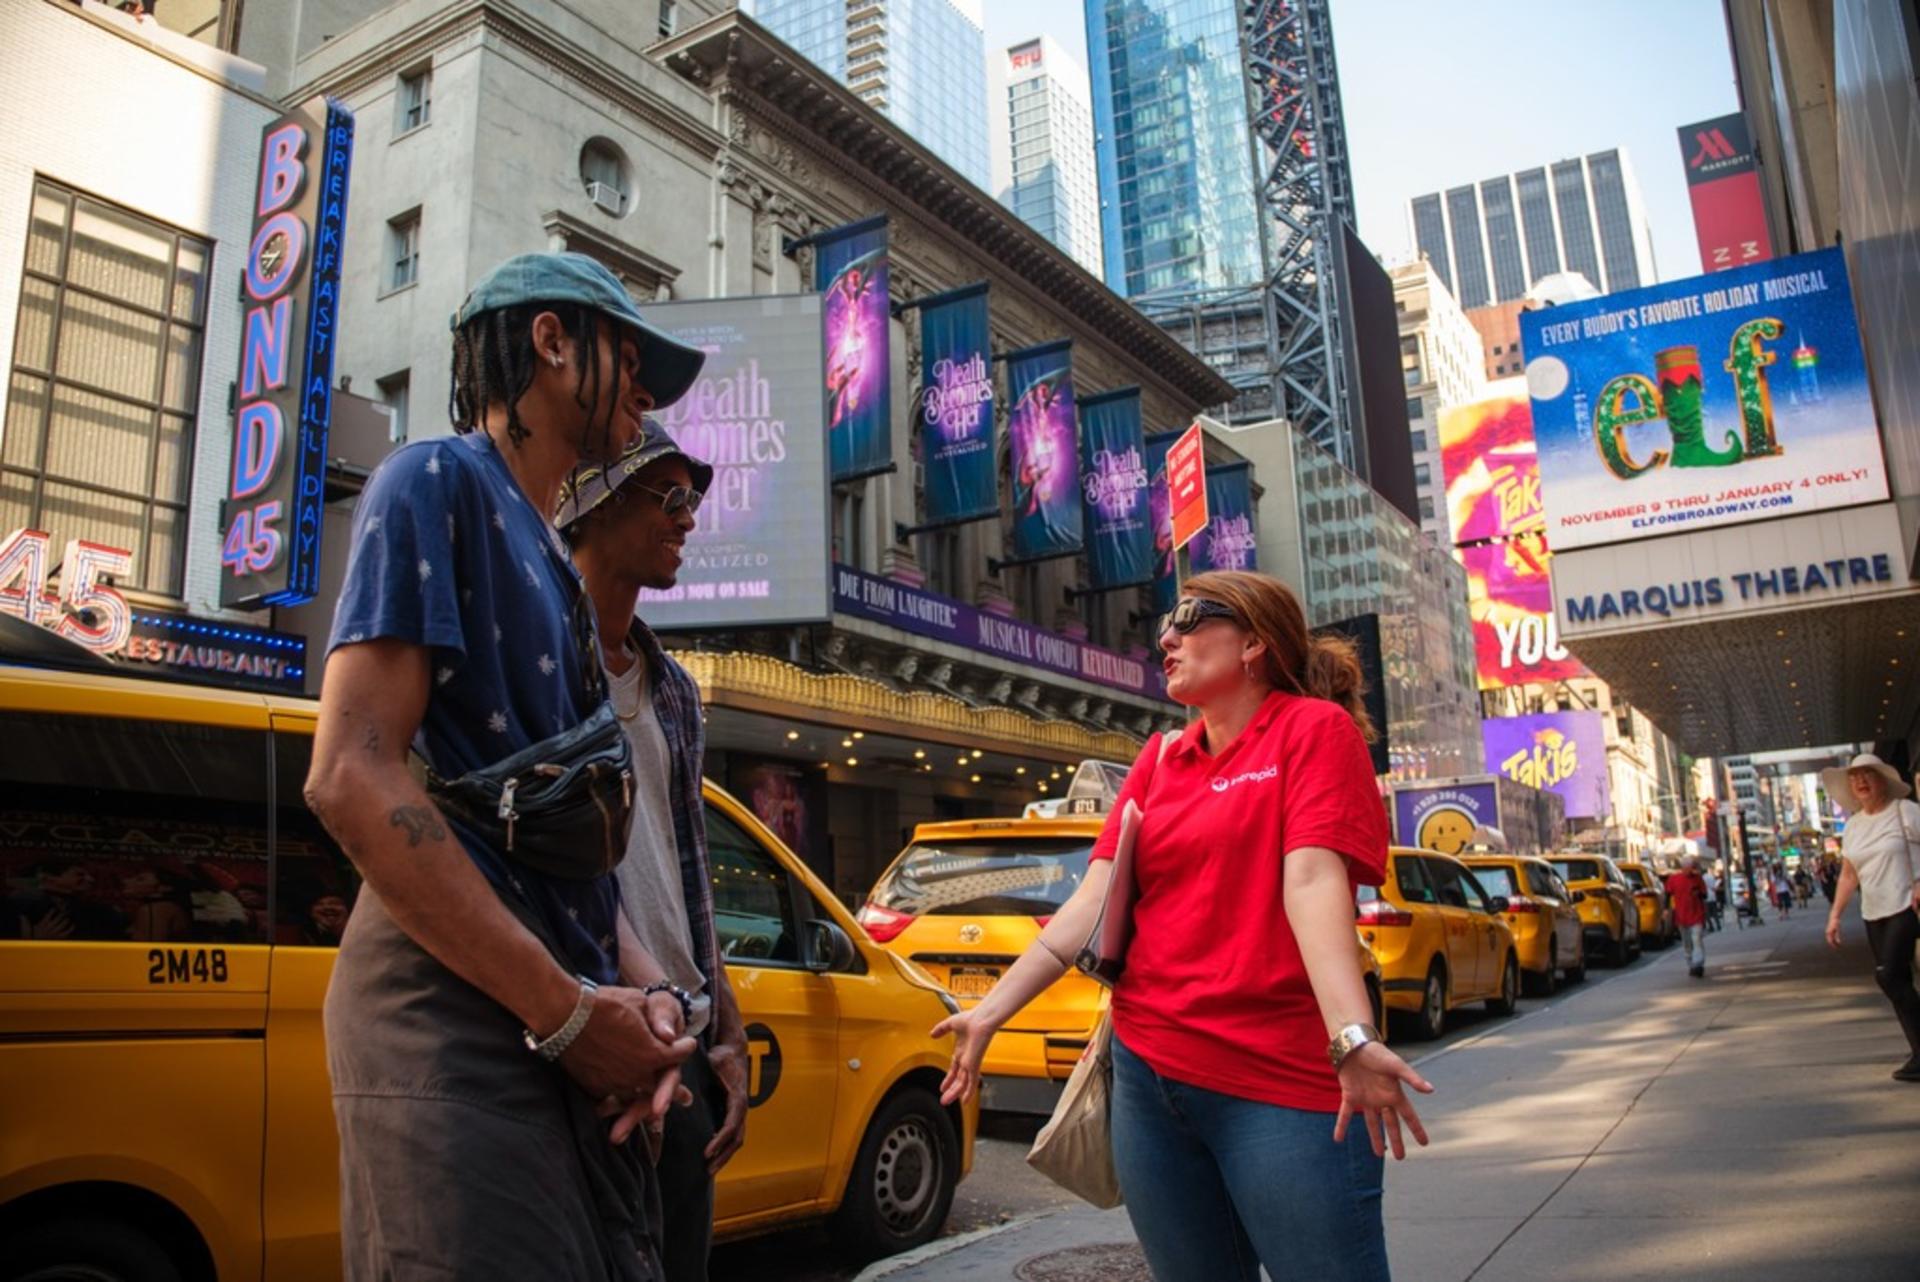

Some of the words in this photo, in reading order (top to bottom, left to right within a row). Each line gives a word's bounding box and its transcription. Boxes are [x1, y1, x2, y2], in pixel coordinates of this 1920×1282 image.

[1701, 154, 1750, 172] MARRIOTT
[315, 127, 348, 353] BREAKFAST
[231, 123, 306, 500] BOND
[1541, 319, 1581, 347] EVERY
[1583, 307, 1639, 338] BUDDY'S
[1640, 295, 1702, 326] FAVORITE
[1703, 282, 1760, 314] HOLIDAY
[1764, 269, 1829, 300] MUSICAL
[932, 352, 986, 394] Death
[308, 376, 325, 452] ALL
[1561, 504, 1647, 527] NOVEMBER
[1650, 502, 1661, 514] 9
[1666, 493, 1710, 511] THRU
[1715, 480, 1793, 503] JANUARY
[1800, 477, 1811, 490] 4
[1816, 469, 1869, 487] ONLY!
[1631, 495, 1793, 529] ELFONBROADWAY.COM
[222, 501, 283, 577] 45
[686, 553, 769, 569] TALIZED
[0, 528, 133, 655] 45
[840, 570, 860, 600] DIE
[863, 578, 895, 612] FROM
[1566, 578, 1725, 624] MARQUIS
[1731, 553, 1892, 600] THEATRE
[977, 614, 1033, 659] MUSICAL
[1035, 632, 1078, 671] COMEDY
[1501, 733, 1577, 790] Takis
[148, 948, 228, 984] 2M48
